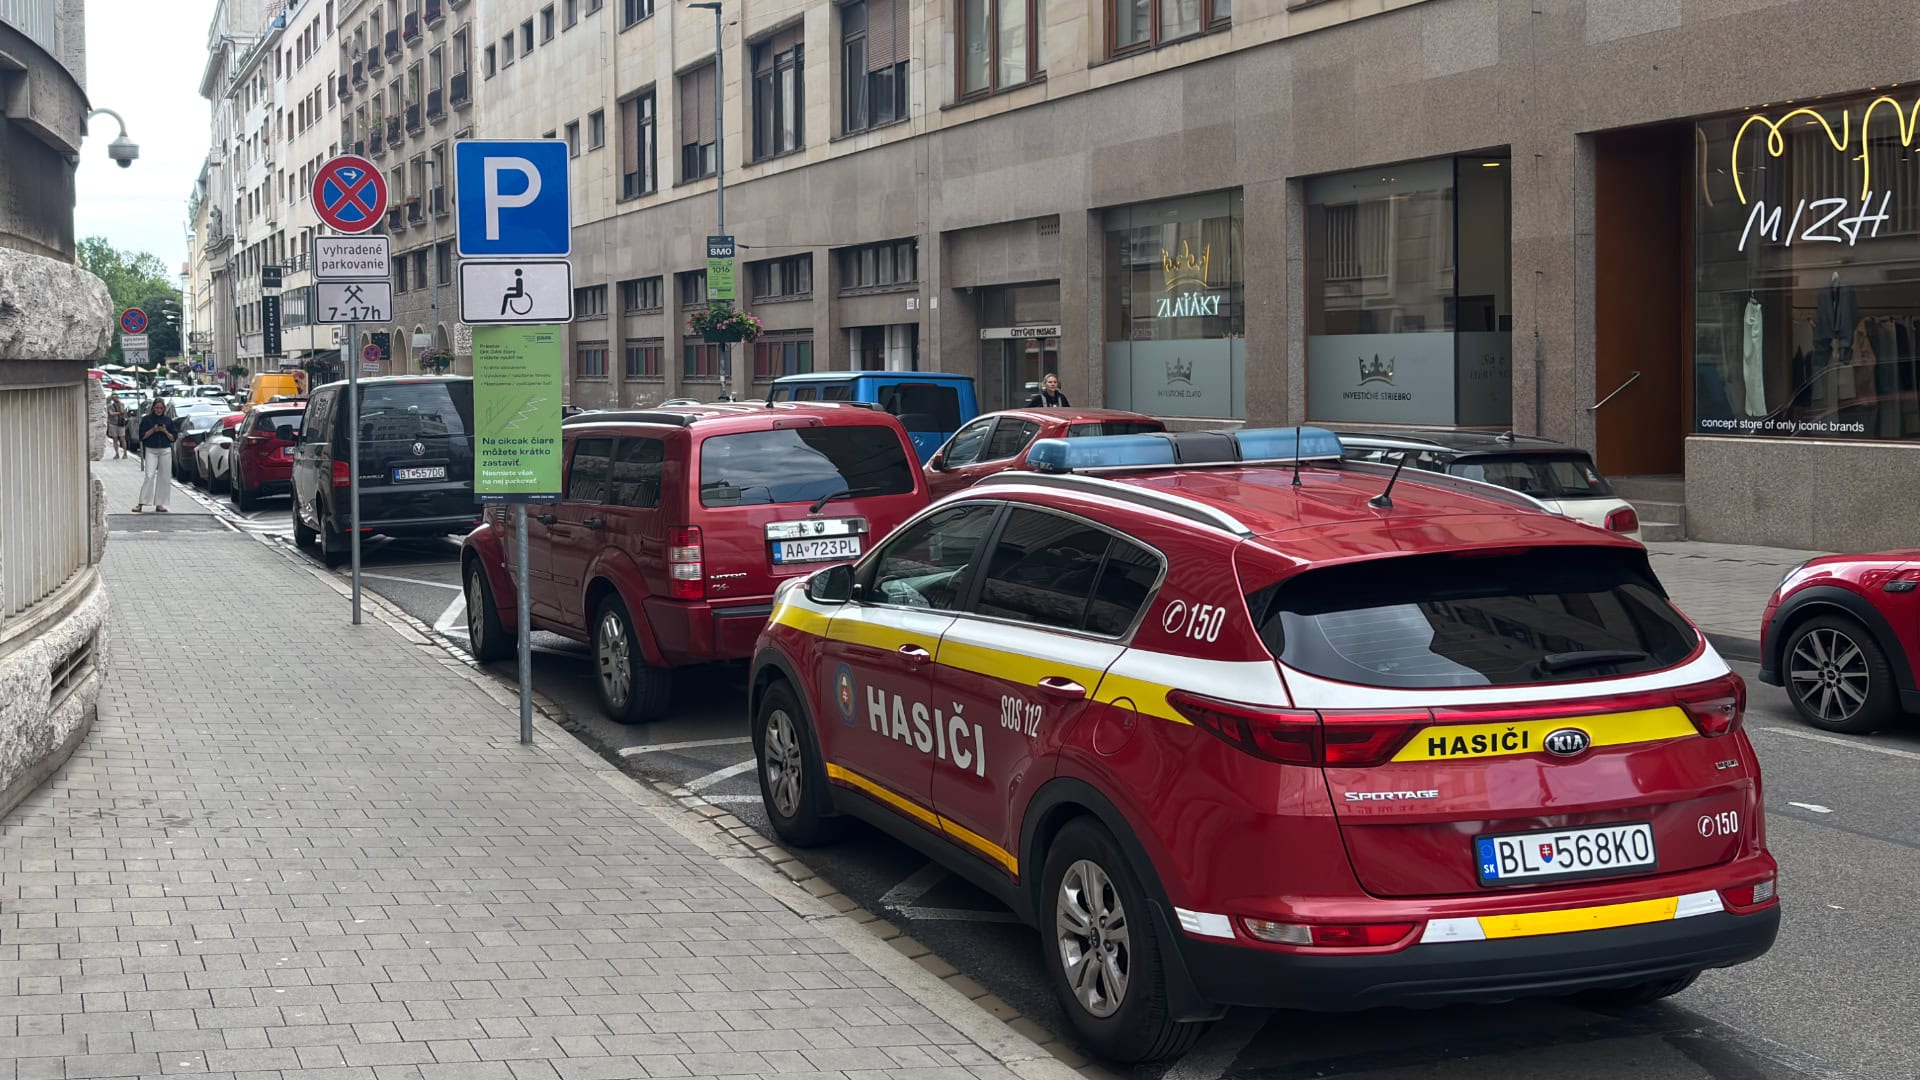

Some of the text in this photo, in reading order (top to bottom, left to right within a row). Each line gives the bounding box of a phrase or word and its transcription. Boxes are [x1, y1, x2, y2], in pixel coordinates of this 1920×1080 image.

[484, 156, 542, 241] P
[1738, 191, 1892, 252] MIZH
[323, 244, 383, 257] vyhradené
[321, 258, 384, 272] parkovanie
[1011, 328, 1023, 337] CITY
[1023, 327, 1036, 337] GATE
[1701, 418, 1865, 433] concept store of only iconic brands
[482, 436, 555, 445] Na cikcak čiare
[482, 447, 551, 456] môžete krátko
[1185, 603, 1226, 643] 150
[1001, 694, 1042, 738] SOS 112
[866, 685, 985, 778] HASIČI
[1428, 727, 1529, 757] HASIČI
[1553, 734, 1584, 751] KIA
[1715, 810, 1739, 836] 150
[1498, 839, 1540, 874] BL
[1483, 863, 1496, 875] SK
